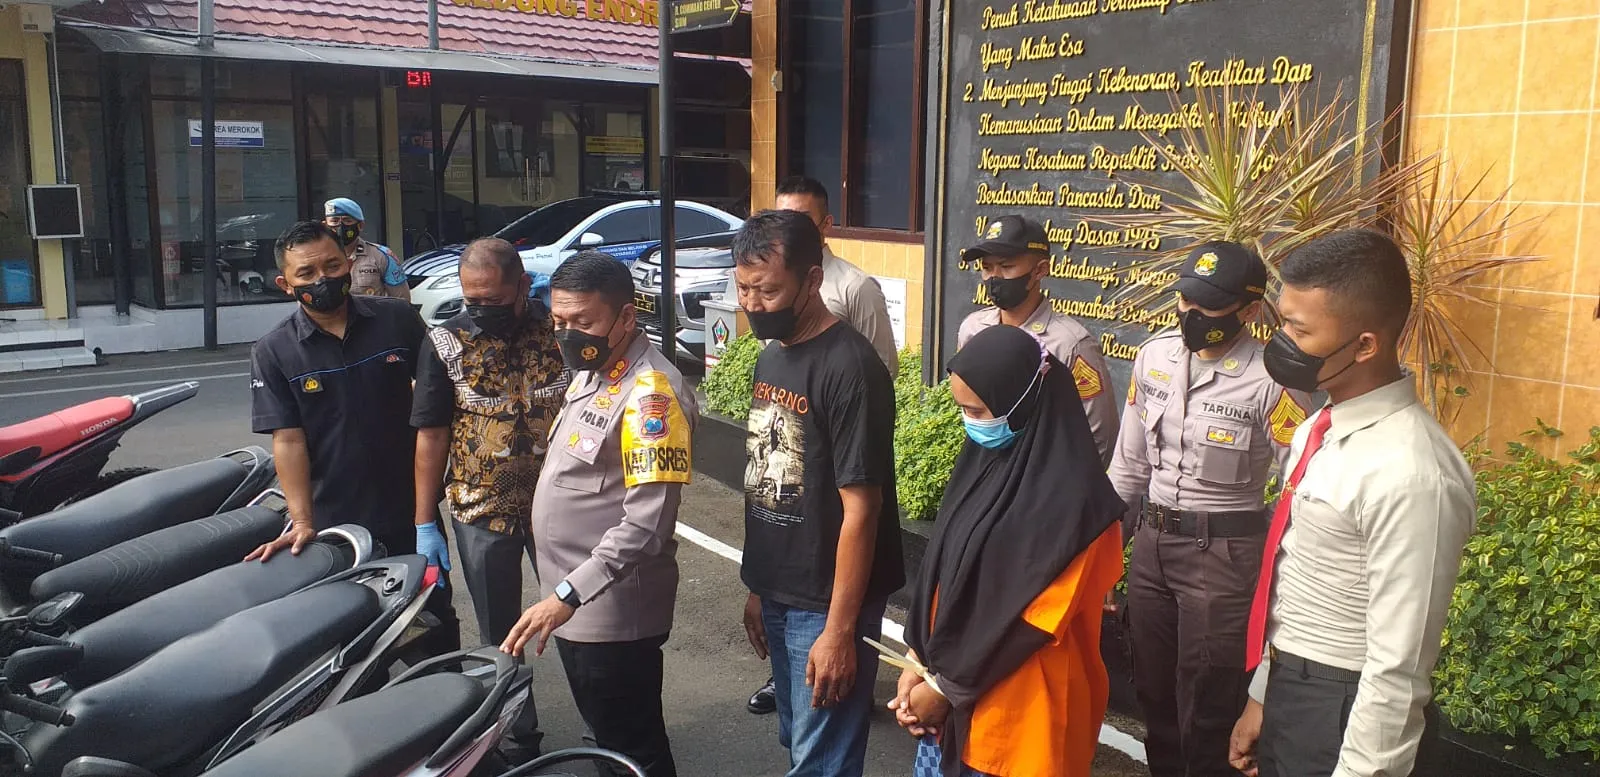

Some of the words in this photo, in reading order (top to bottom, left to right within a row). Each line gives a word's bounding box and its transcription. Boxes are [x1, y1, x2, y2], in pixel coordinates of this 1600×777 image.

[981, 4, 1018, 30] Penuh
[980, 41, 1013, 72] Yang
[1016, 36, 1057, 60] Maha
[1059, 33, 1084, 57] Esa
[963, 83, 974, 102] 2.
[979, 76, 1048, 109] Menjunjung
[1050, 72, 1093, 105] Tinggi
[1271, 56, 1313, 84] Dan
[978, 113, 1062, 137] Kemanusiaan
[1066, 109, 1115, 132] Dalam
[977, 147, 1022, 176] Negara
[1024, 145, 1086, 171] Kesatuan
[976, 182, 1054, 206] Berdasarkan
[1057, 183, 1125, 208] Pancasila
[1128, 185, 1161, 210] Dan
[1075, 221, 1120, 246] Dasar
[1123, 223, 1160, 250] 1945
[579, 410, 609, 431] POLRI
[1202, 402, 1251, 419] TARUNA
[80, 417, 118, 436] HONDA
